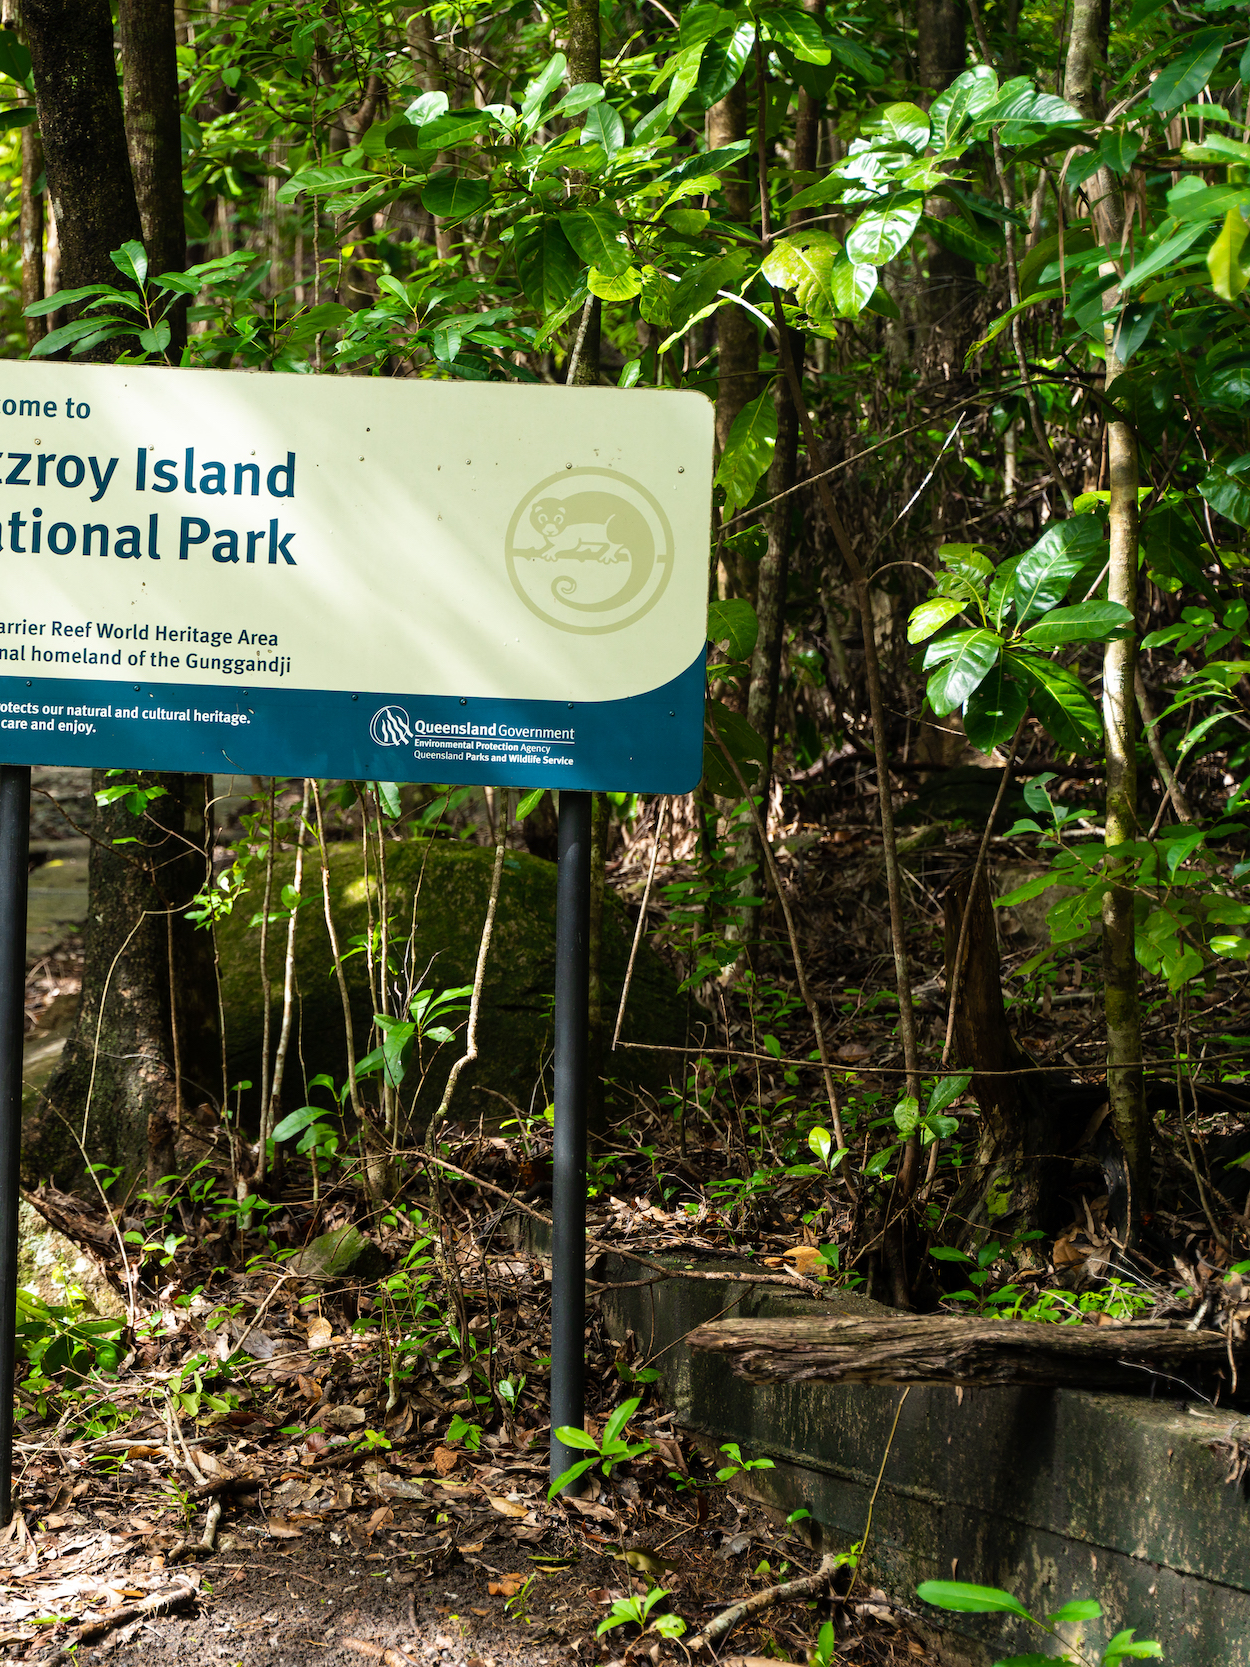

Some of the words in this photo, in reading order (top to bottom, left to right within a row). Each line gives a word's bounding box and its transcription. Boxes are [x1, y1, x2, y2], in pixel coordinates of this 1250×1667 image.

[65, 397, 91, 420] to
[135, 446, 296, 498] Island
[178, 516, 298, 566] Park
[51, 620, 93, 638] Reef
[96, 622, 149, 641] World
[155, 625, 233, 648] Heritage
[237, 629, 278, 647] Area
[31, 645, 122, 665] homeland
[127, 650, 147, 666] of
[150, 651, 180, 668] the
[185, 653, 291, 677] Gunggandji
[0, 718, 28, 730] care
[30, 718, 55, 731] and
[57, 719, 97, 736] enjoy.
[41, 704, 65, 716] our
[66, 704, 113, 718] natural
[114, 705, 139, 719] and
[141, 706, 191, 722] cultural
[193, 708, 252, 727] heritage.
[414, 719, 497, 736] Queensland
[497, 724, 575, 740] Government
[413, 749, 464, 761] Queensland
[465, 752, 490, 762] Parks
[490, 753, 508, 763] and
[508, 753, 542, 765] Wildlife
[542, 755, 574, 766] Service
[414, 738, 475, 750] Environmental
[475, 741, 519, 752] Protection
[519, 743, 552, 755] Agency
